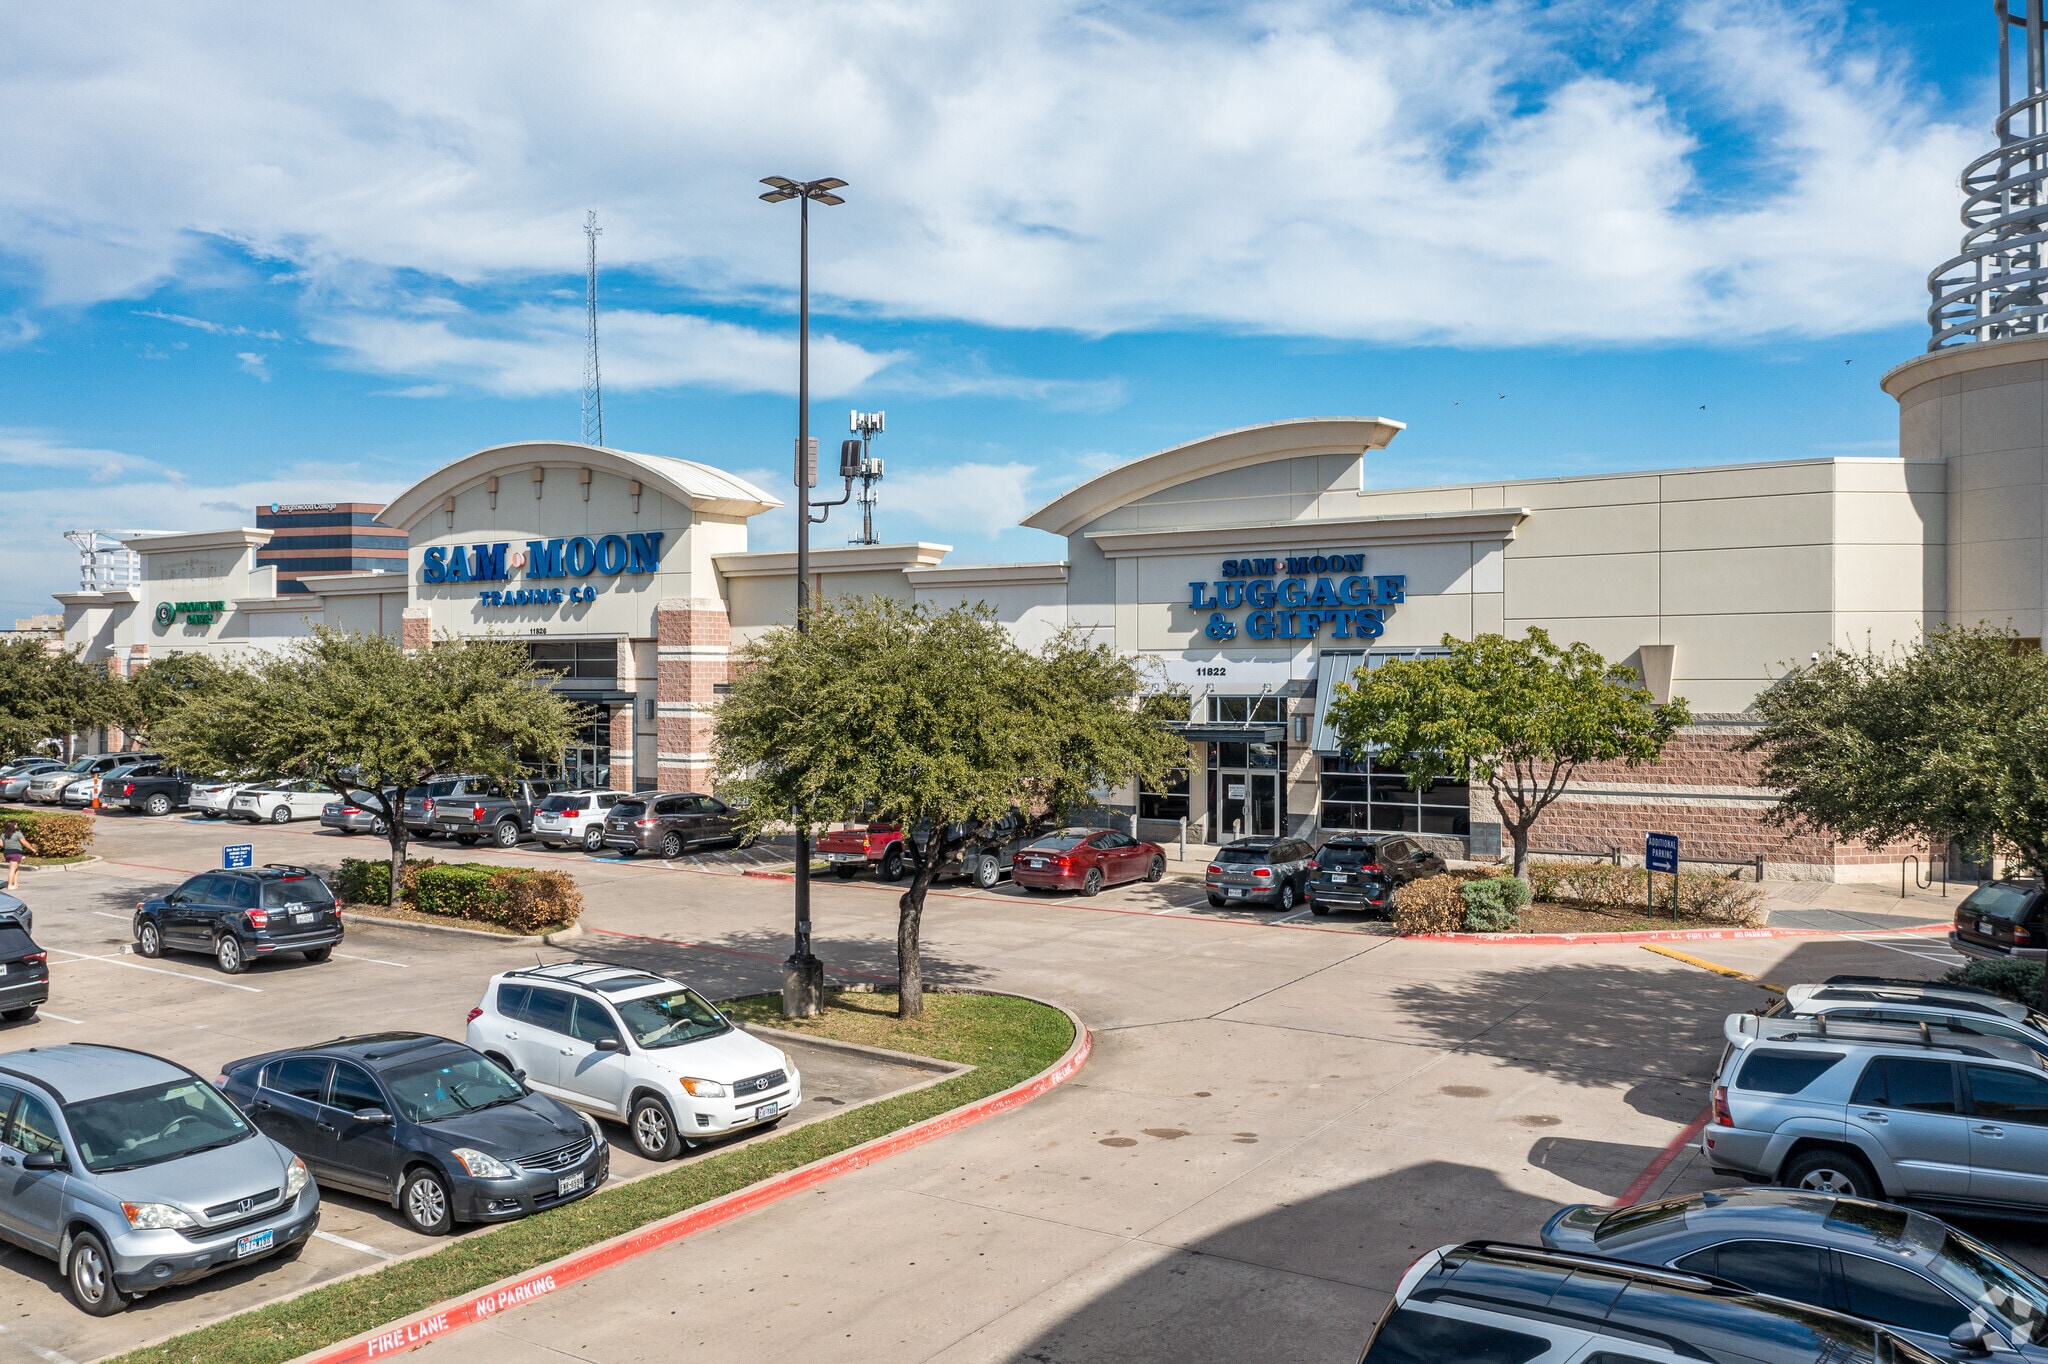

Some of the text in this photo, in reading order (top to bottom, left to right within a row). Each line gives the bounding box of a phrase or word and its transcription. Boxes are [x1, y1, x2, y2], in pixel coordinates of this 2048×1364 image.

[314, 503, 336, 511] College
[423, 532, 663, 583] SAM MOON
[1222, 554, 1365, 577] SAM MOON
[480, 586, 598, 606] TRADING CO
[1188, 575, 1407, 609] LUGGAGE
[1205, 609, 1385, 640] & GIFTS
[1197, 667, 1226, 676] 11822
[1649, 838, 1676, 849] ADDITIONAL
[1652, 848, 1673, 859] PARKING
[1744, 930, 1773, 938] PARKING
[475, 1275, 556, 1317] NO PARKING
[367, 1313, 449, 1356] FIRE LANE
